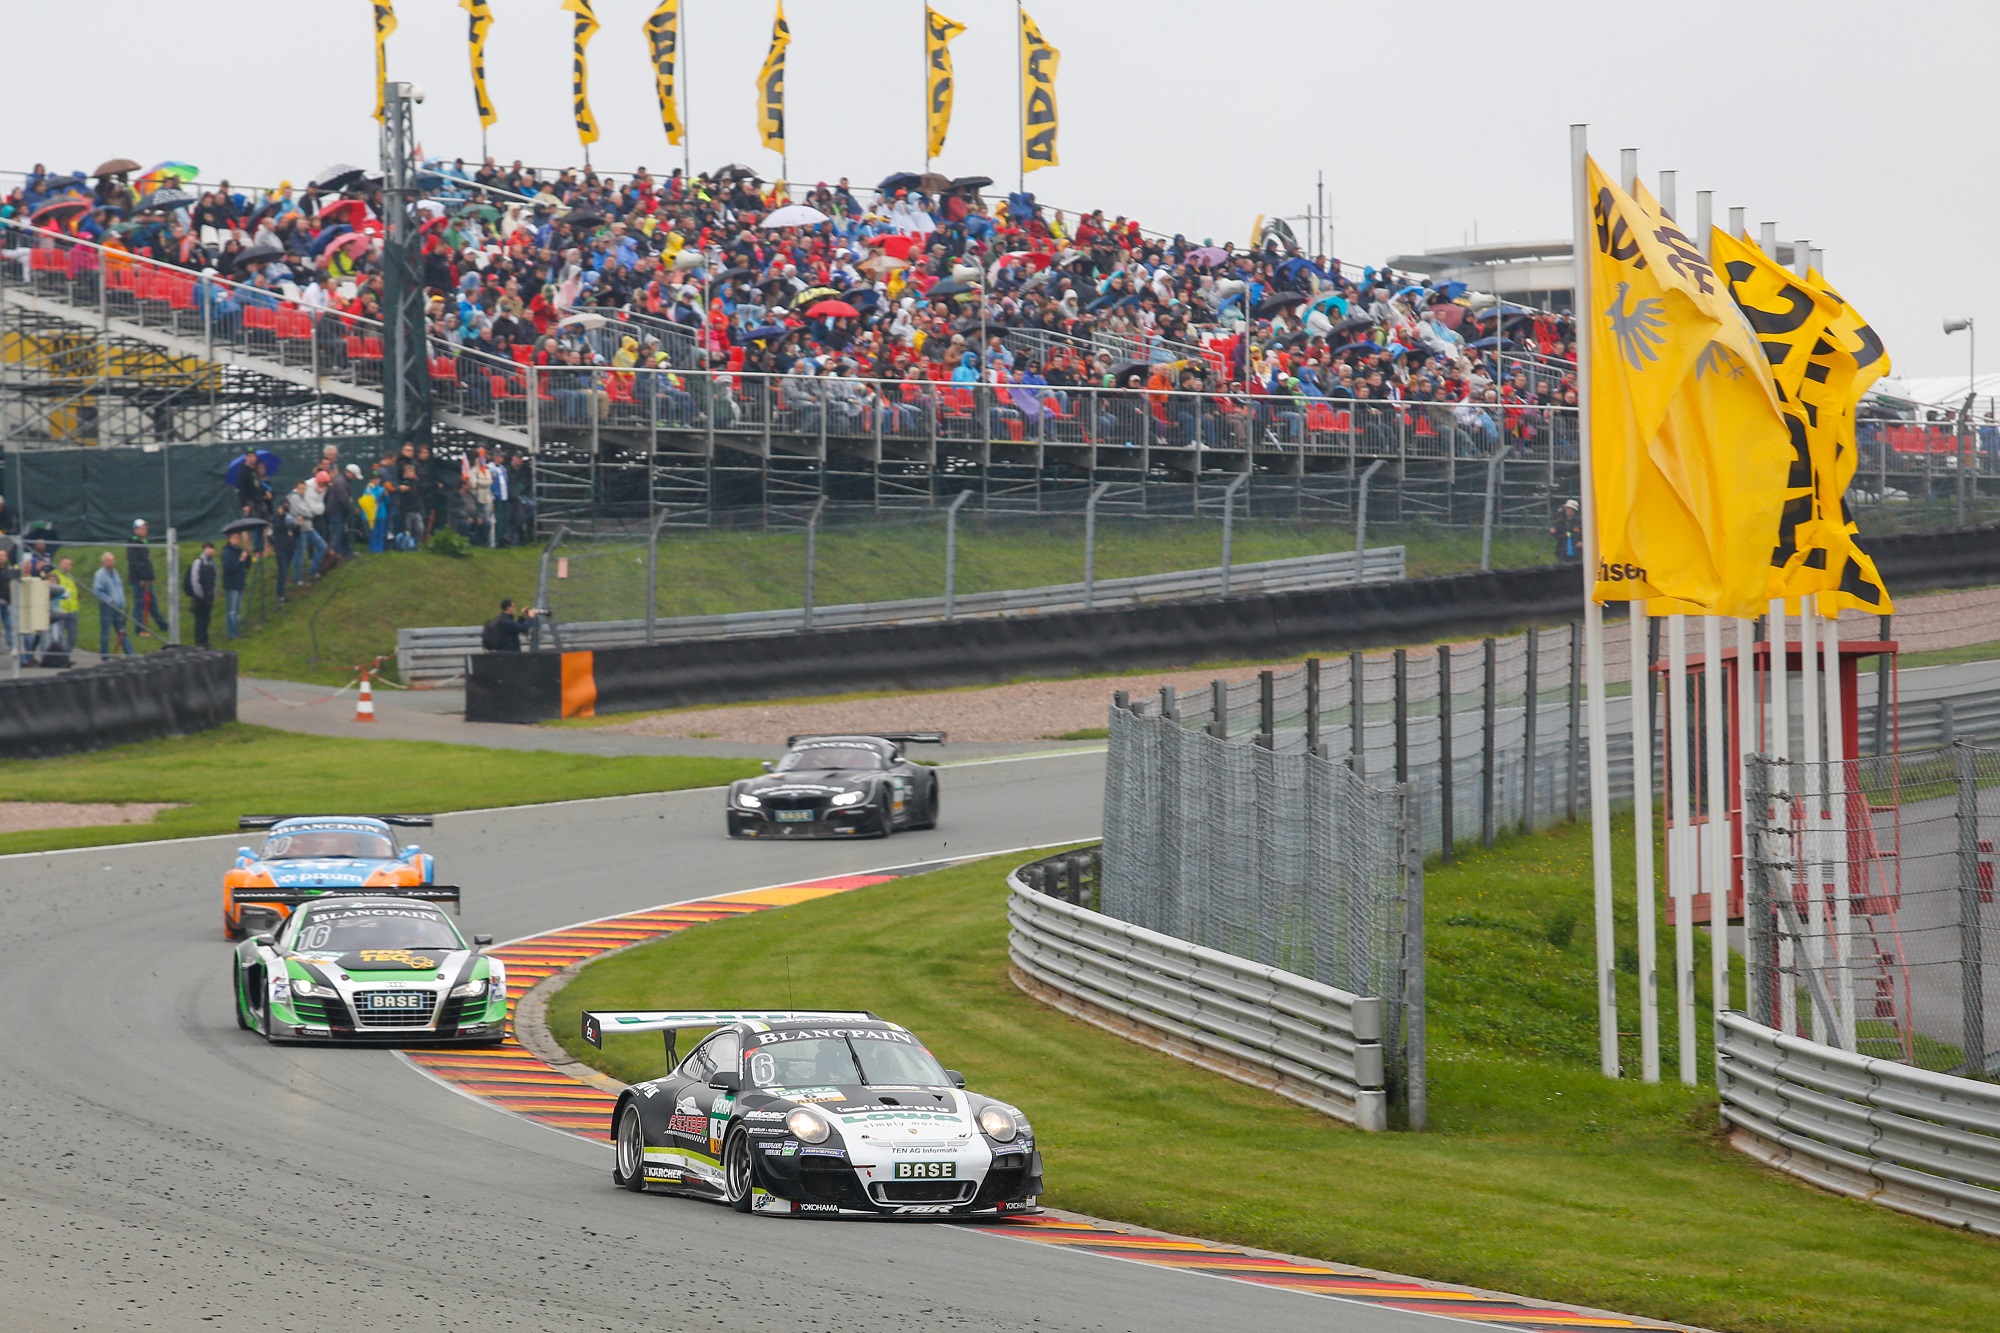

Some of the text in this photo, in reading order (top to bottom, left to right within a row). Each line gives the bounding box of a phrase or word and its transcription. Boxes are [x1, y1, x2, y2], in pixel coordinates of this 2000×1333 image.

[300, 872, 363, 885] pixum
[311, 908, 438, 924] BLANCPAIN
[298, 924, 332, 950] 16
[373, 996, 418, 1007] BASE
[756, 1029, 912, 1045] BLANCPAIN
[751, 1053, 776, 1086] 6
[777, 1086, 838, 1097] DEKRA
[711, 1097, 732, 1115] DEKRA
[841, 1112, 963, 1123] LOWA
[716, 1120, 722, 1138] 6
[899, 1163, 953, 1177] BASE
[800, 1203, 839, 1211] YOKOHAMA
